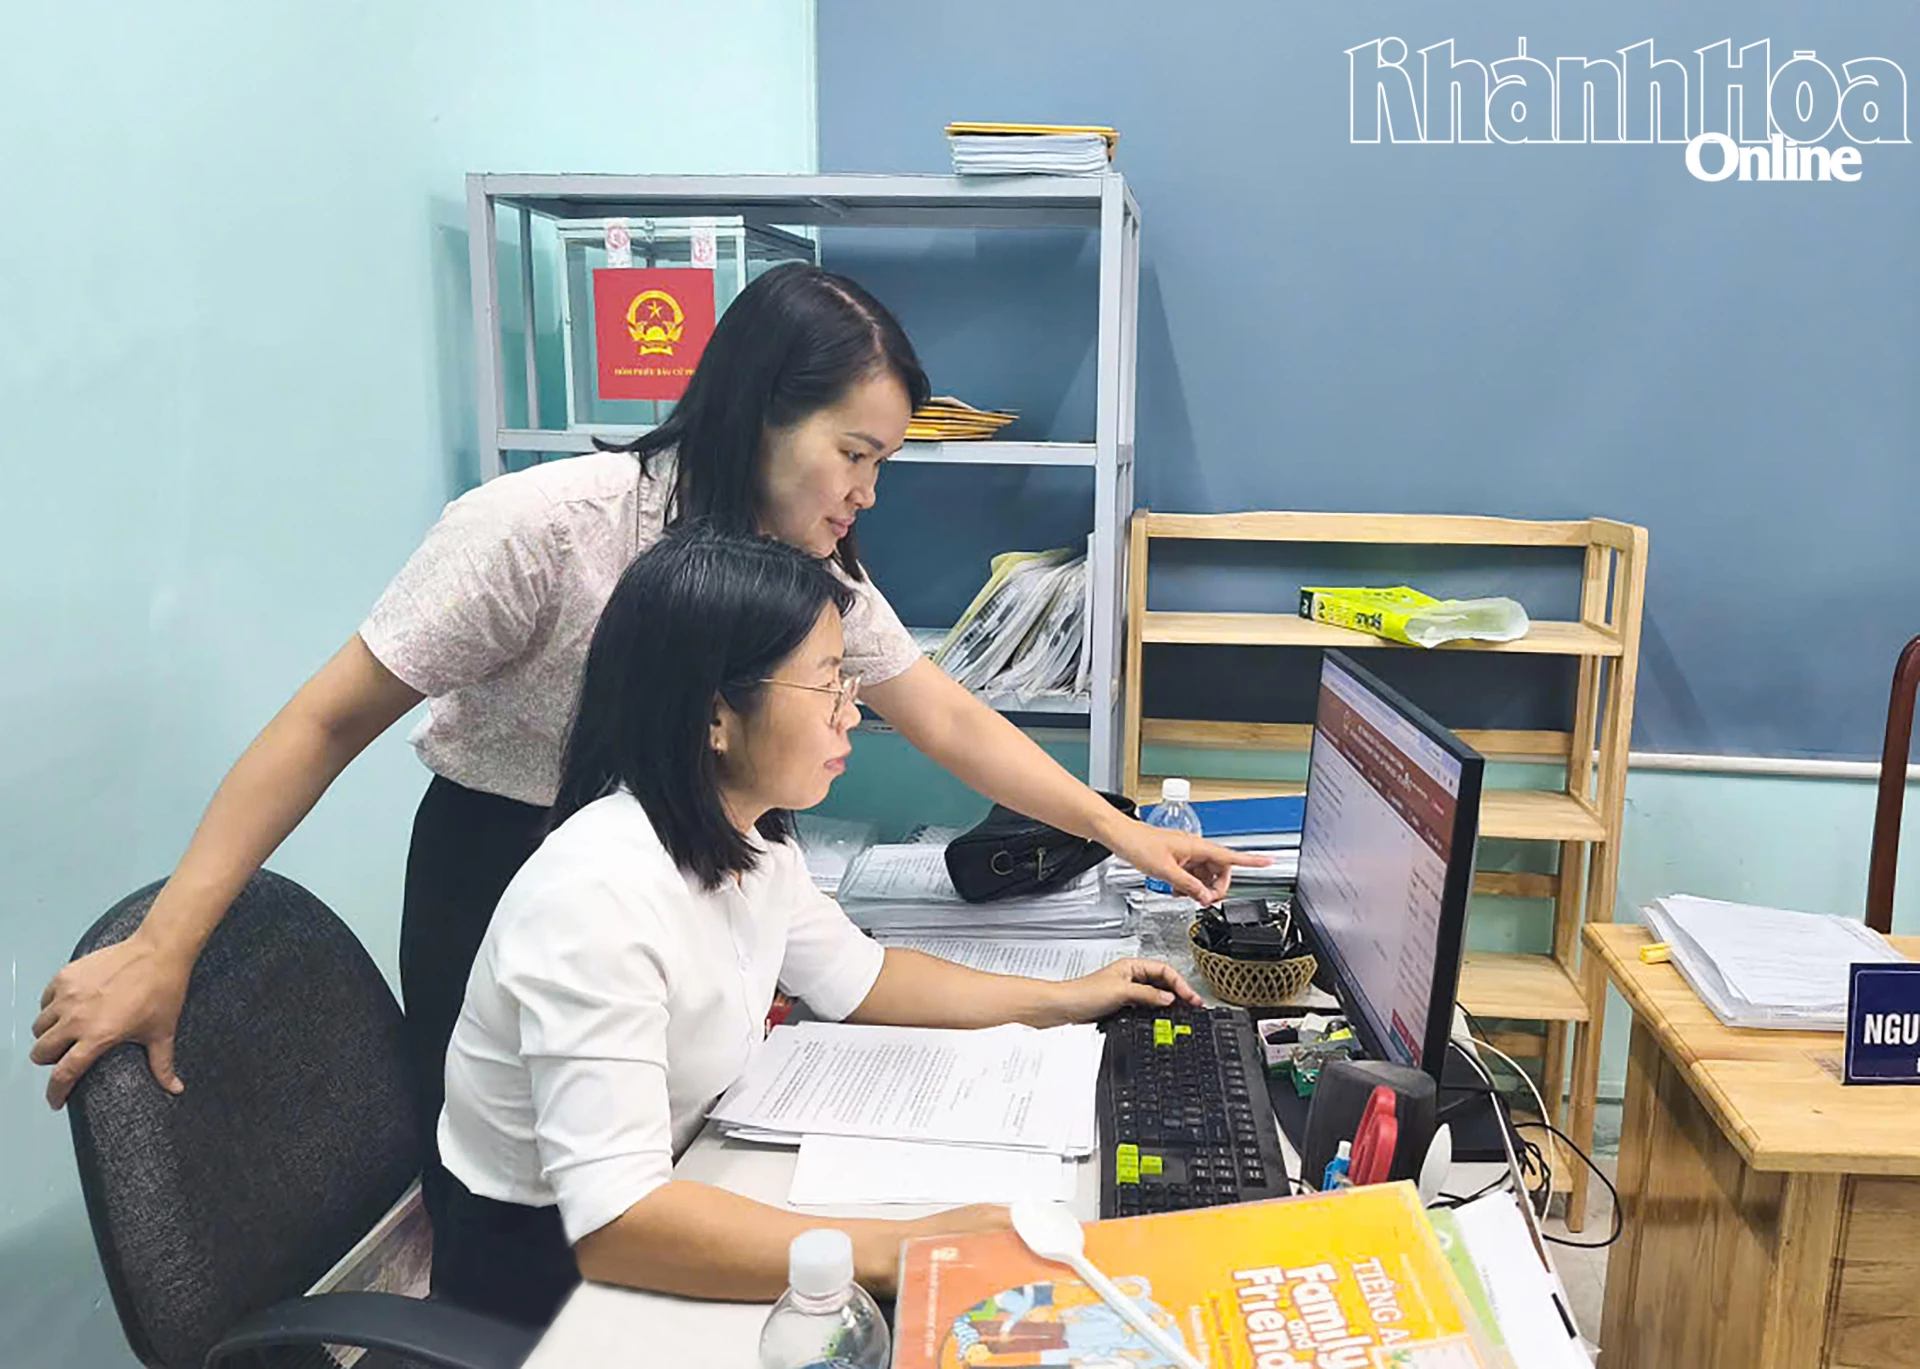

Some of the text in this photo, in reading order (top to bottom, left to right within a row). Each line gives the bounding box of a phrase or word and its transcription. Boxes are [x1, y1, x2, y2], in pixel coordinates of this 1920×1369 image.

[1863, 1013, 1920, 1045] NGU
[1286, 1263, 1373, 1368] Family
[1287, 1319, 1319, 1351] and
[1379, 1327, 1410, 1348] A
